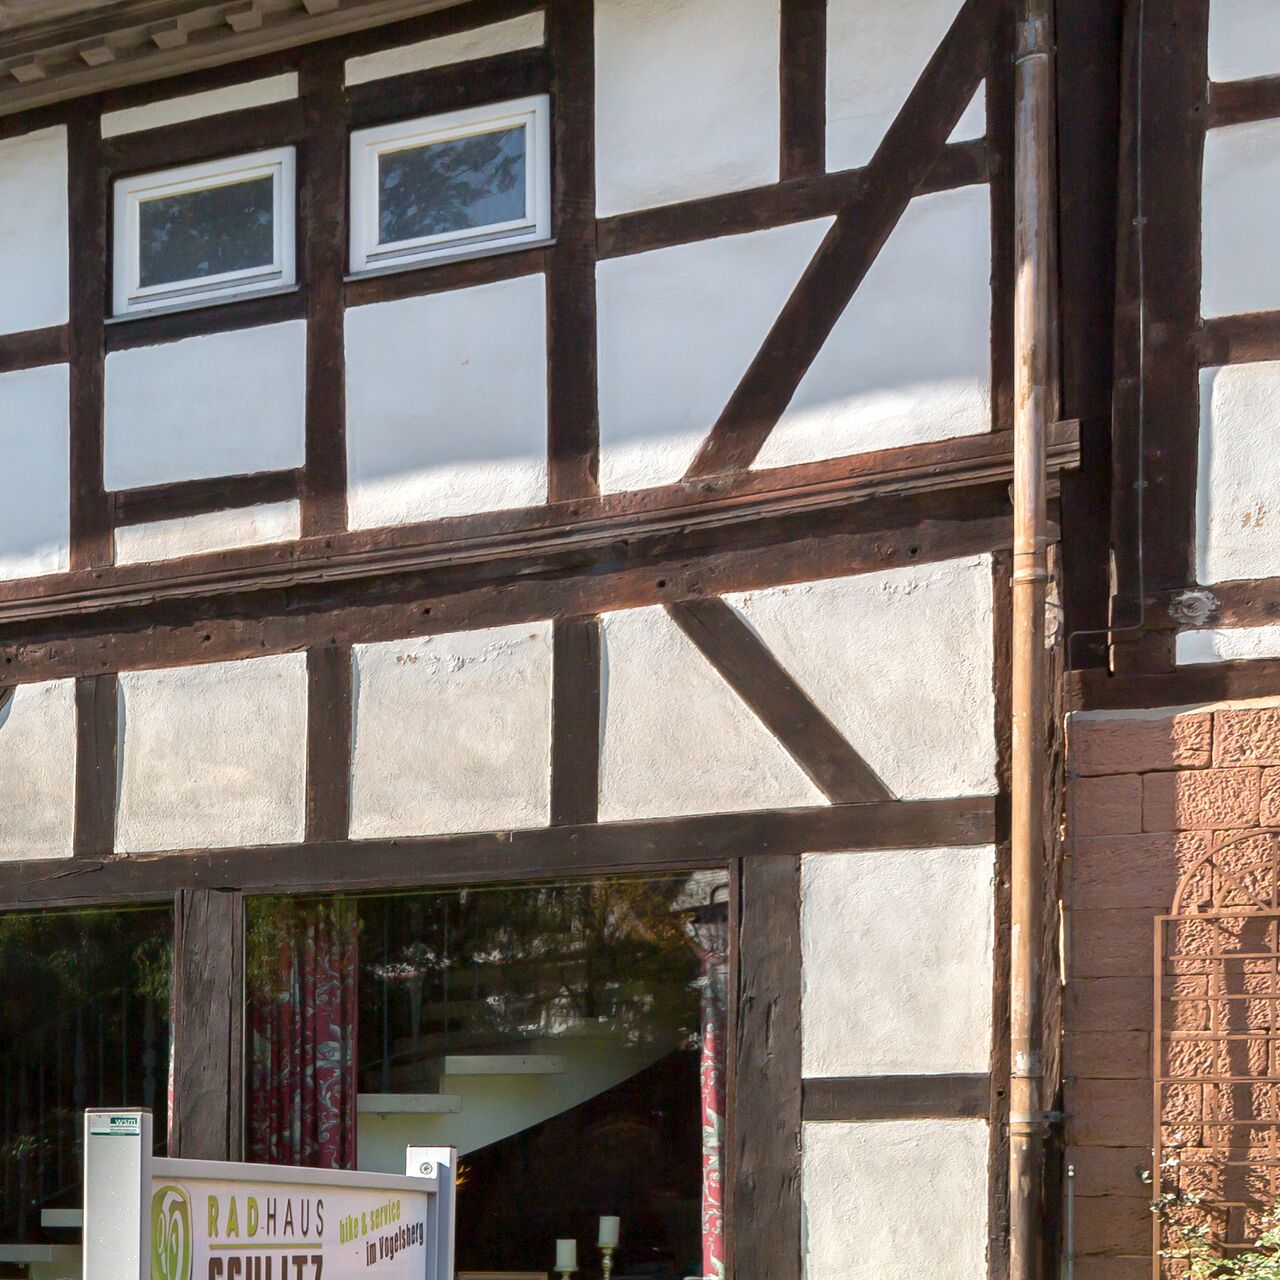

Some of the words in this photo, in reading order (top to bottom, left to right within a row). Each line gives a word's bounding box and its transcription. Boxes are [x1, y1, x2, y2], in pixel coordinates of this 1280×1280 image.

[339, 1214, 359, 1246] bike
[361, 1211, 368, 1236] &
[370, 1199, 401, 1233] service
[366, 1241, 377, 1267] im
[378, 1222, 424, 1261] Vogelsberg
